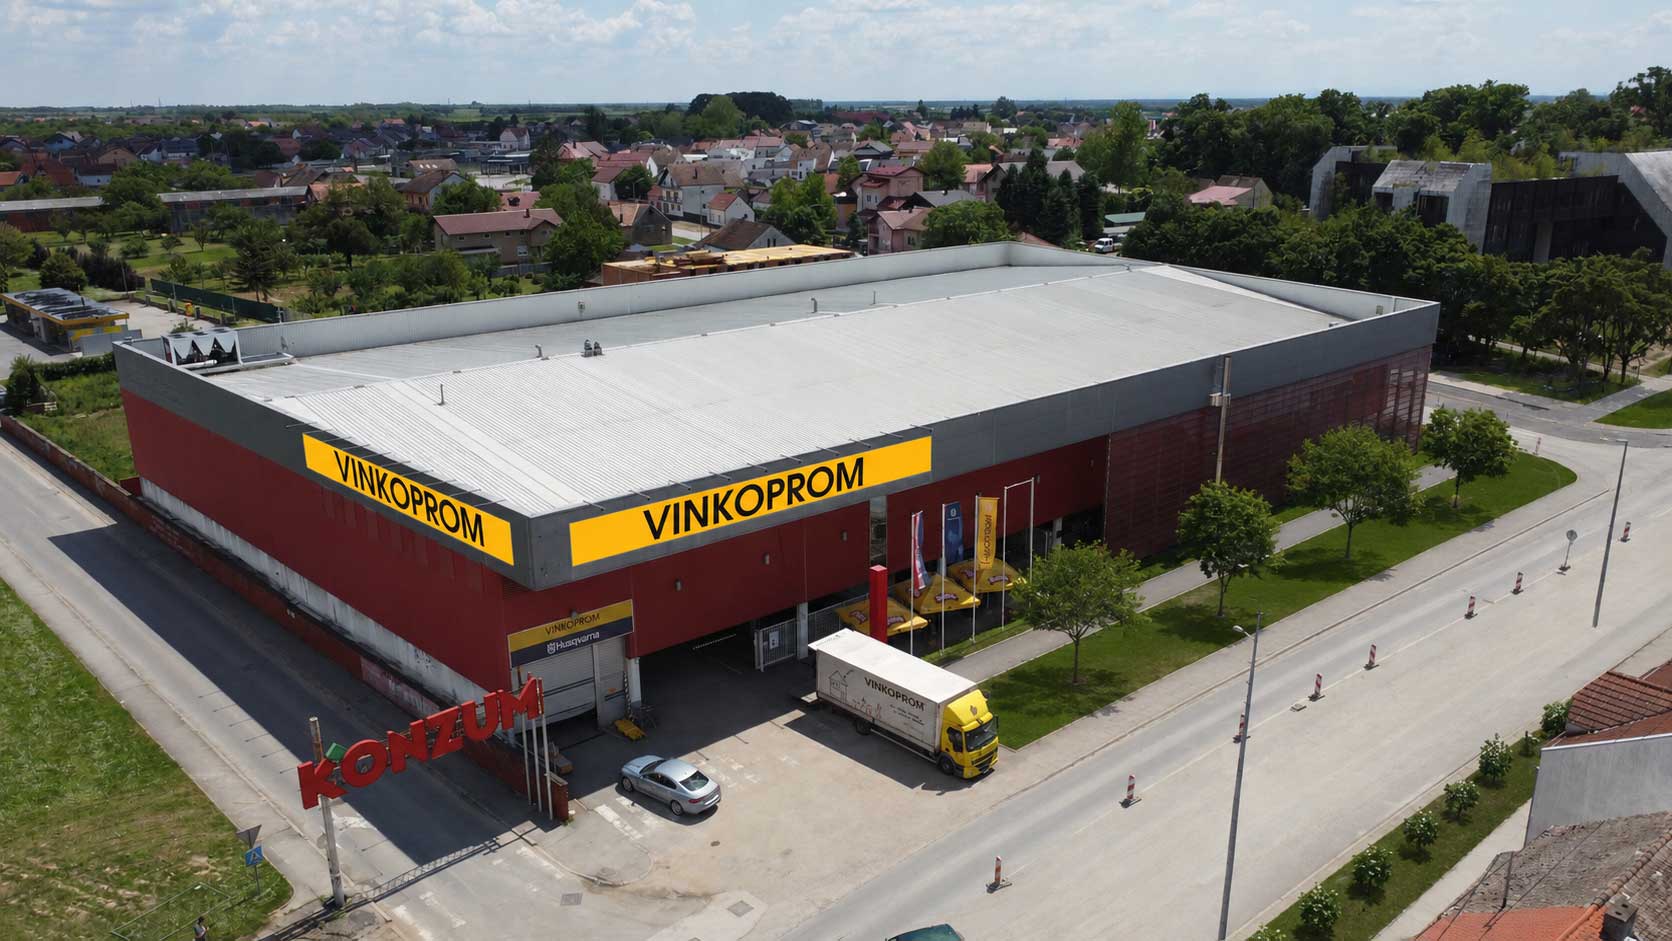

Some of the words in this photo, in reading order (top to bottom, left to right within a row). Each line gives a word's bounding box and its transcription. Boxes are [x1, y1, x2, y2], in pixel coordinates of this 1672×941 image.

[333, 449, 485, 547] VINKOPROM
[643, 457, 864, 540] VINKOPROM
[545, 613, 600, 635] VINKOPROM
[556, 631, 600, 651] Husqvarna
[864, 676, 925, 712] VINKOPROM
[297, 677, 539, 809] KONZUM
